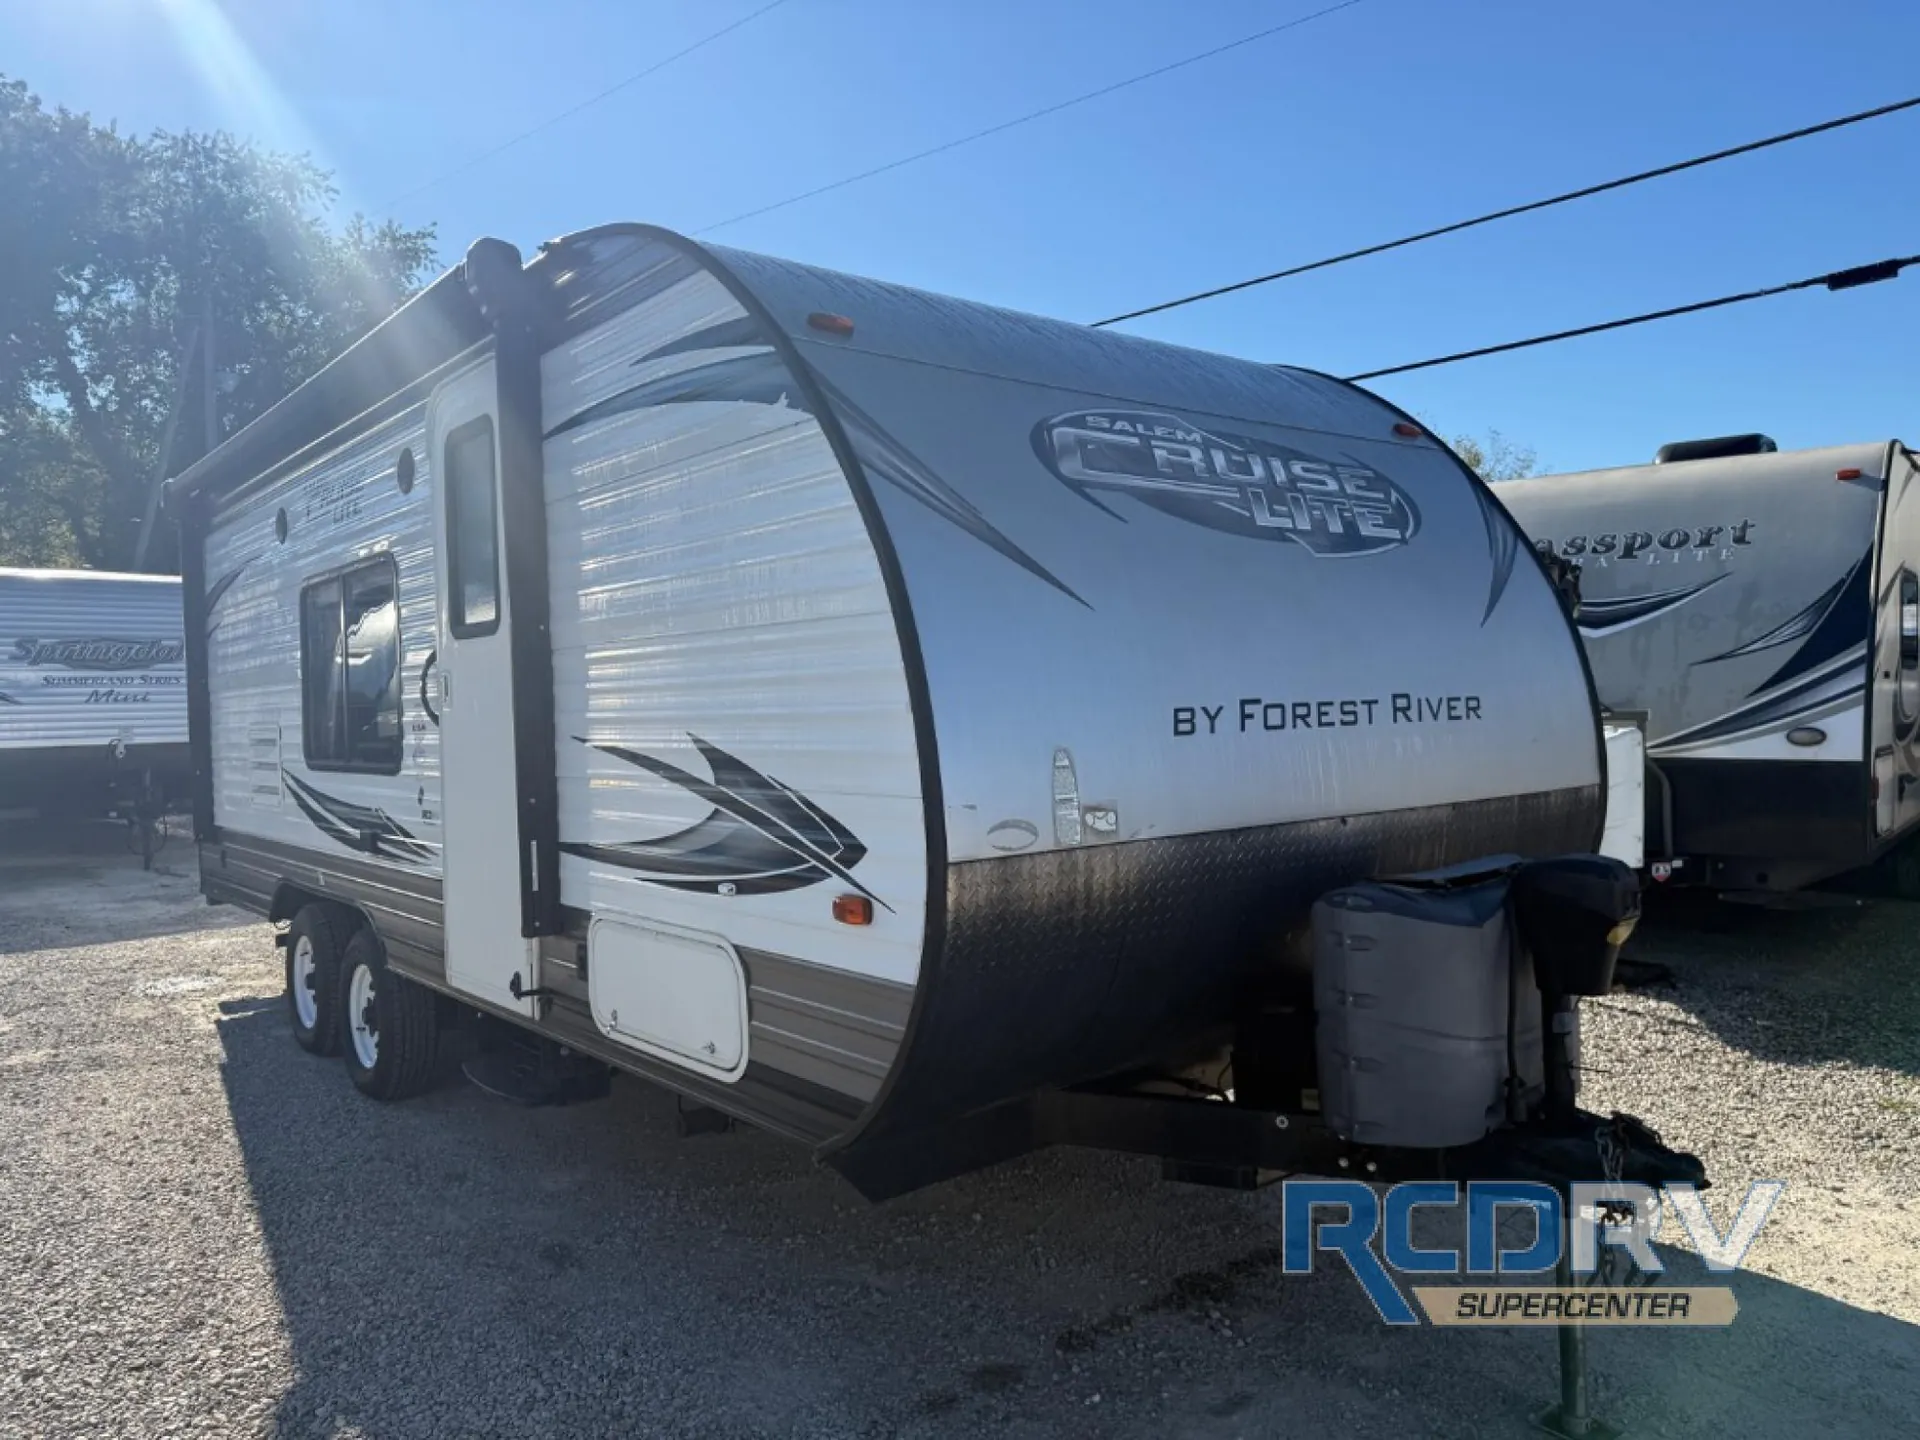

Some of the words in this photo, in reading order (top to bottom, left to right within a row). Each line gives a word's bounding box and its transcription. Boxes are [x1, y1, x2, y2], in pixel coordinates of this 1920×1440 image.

[1085, 414, 1202, 444] SALEM
[1052, 426, 1385, 498] CRUISE
[1247, 486, 1402, 539] LITE
[1645, 549, 1735, 566] LITE
[84, 688, 150, 703] Mini
[1173, 705, 1224, 736] BY
[1239, 698, 1379, 732] FOREST
[1391, 693, 1482, 723] RIVER
